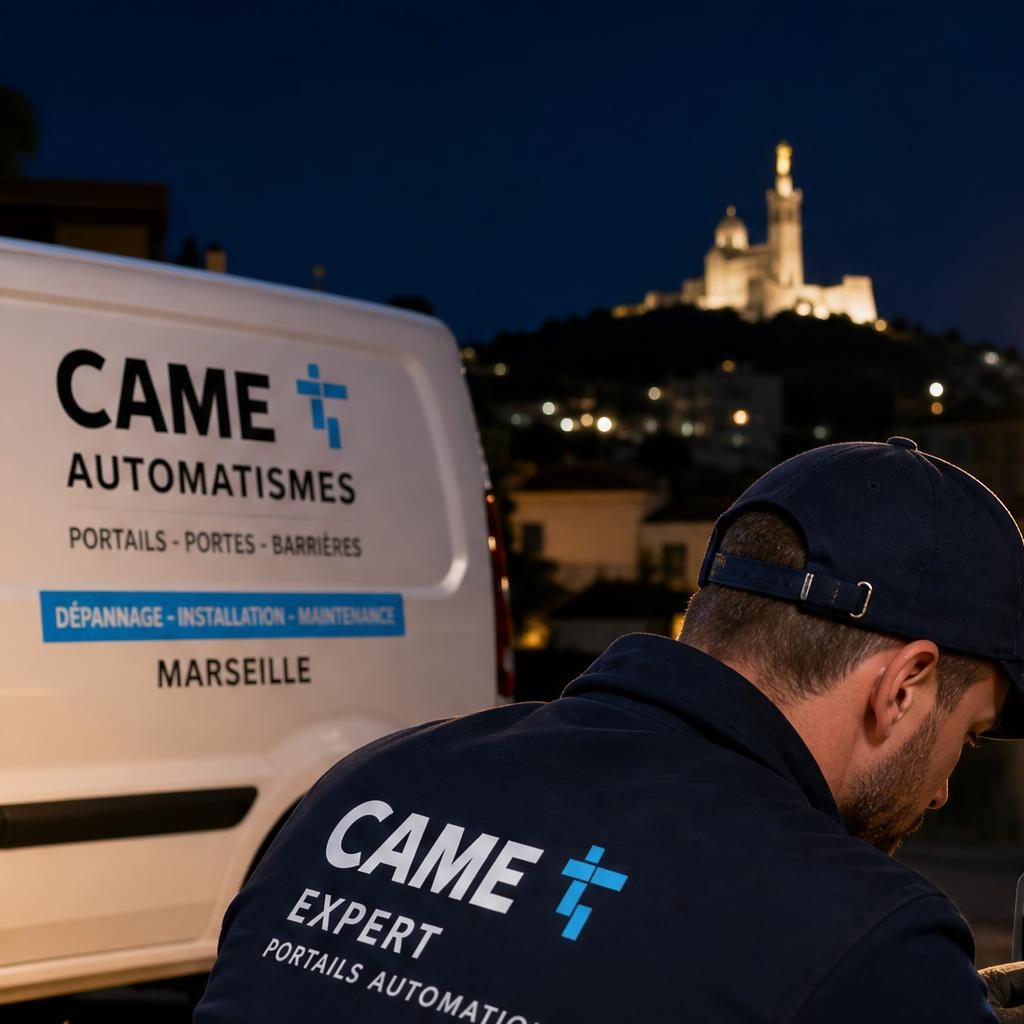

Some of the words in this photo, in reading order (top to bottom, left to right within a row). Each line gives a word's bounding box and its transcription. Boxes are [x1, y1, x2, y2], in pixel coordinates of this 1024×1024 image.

[56, 348, 276, 443] CAME
[66, 452, 356, 505] AUTOMATISMES
[69, 526, 167, 553] PORTAILS
[185, 531, 256, 555] PORTES
[272, 530, 362, 558] BARRIÈRES
[55, 601, 163, 629] DÉPANNAGE
[177, 605, 286, 627] INSTALLATION
[298, 605, 396, 627] MAINTENANCE
[157, 656, 312, 689] MARSEILLE
[325, 800, 544, 914] CAME
[286, 887, 444, 959] EXPERT
[262, 938, 364, 985] PORTAILS
